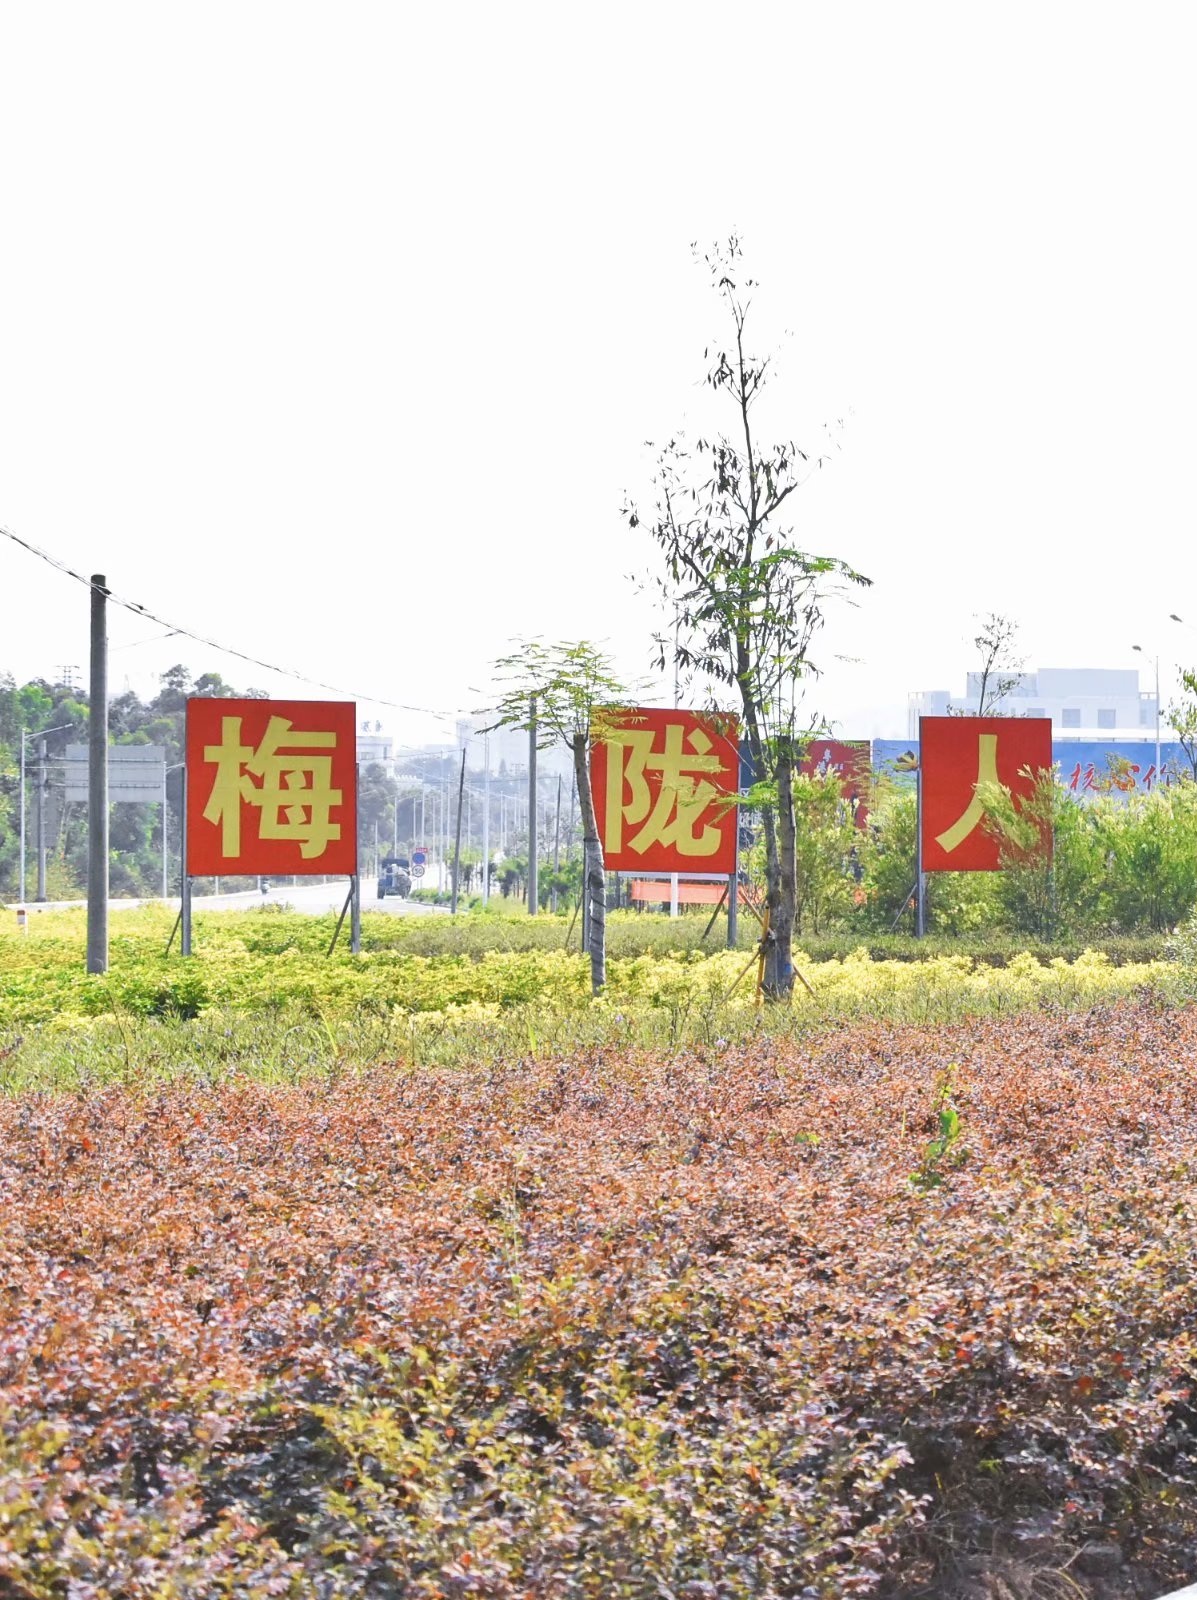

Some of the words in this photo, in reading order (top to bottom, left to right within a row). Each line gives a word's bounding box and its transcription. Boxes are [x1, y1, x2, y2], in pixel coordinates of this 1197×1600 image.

[202, 715, 343, 859] 梅
[604, 724, 722, 857] 陇
[934, 734, 1041, 854] 人
